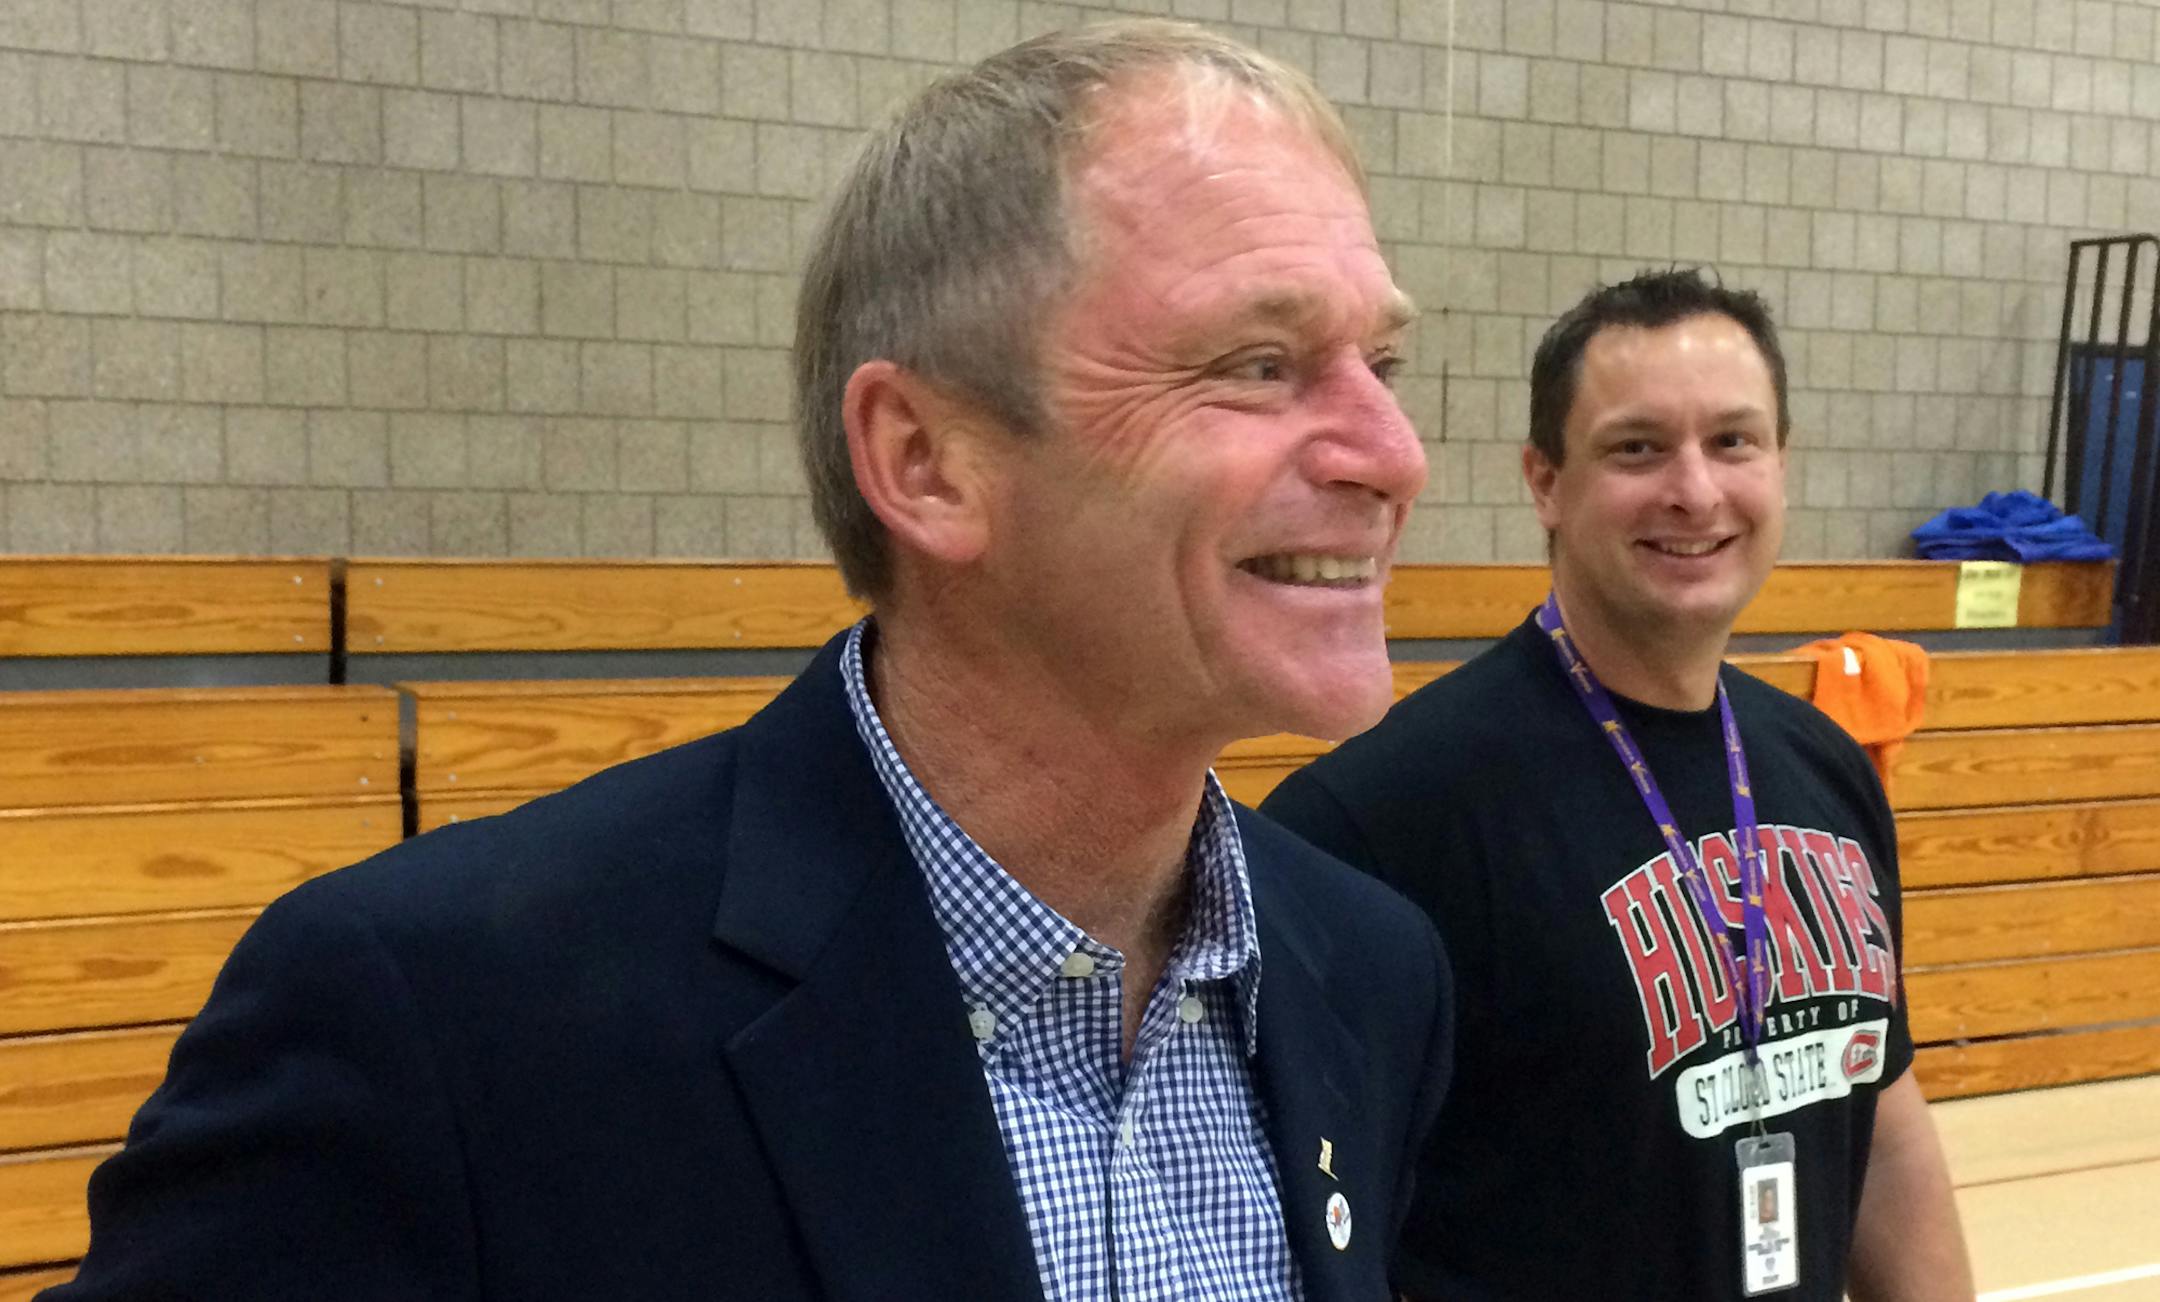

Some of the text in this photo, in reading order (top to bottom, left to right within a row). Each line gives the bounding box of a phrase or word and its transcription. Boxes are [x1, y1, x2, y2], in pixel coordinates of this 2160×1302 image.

[1722, 998, 1859, 1049] PRERTY OF
[1695, 1073, 1719, 1127] ST
[1772, 1042, 1826, 1101] STATE
